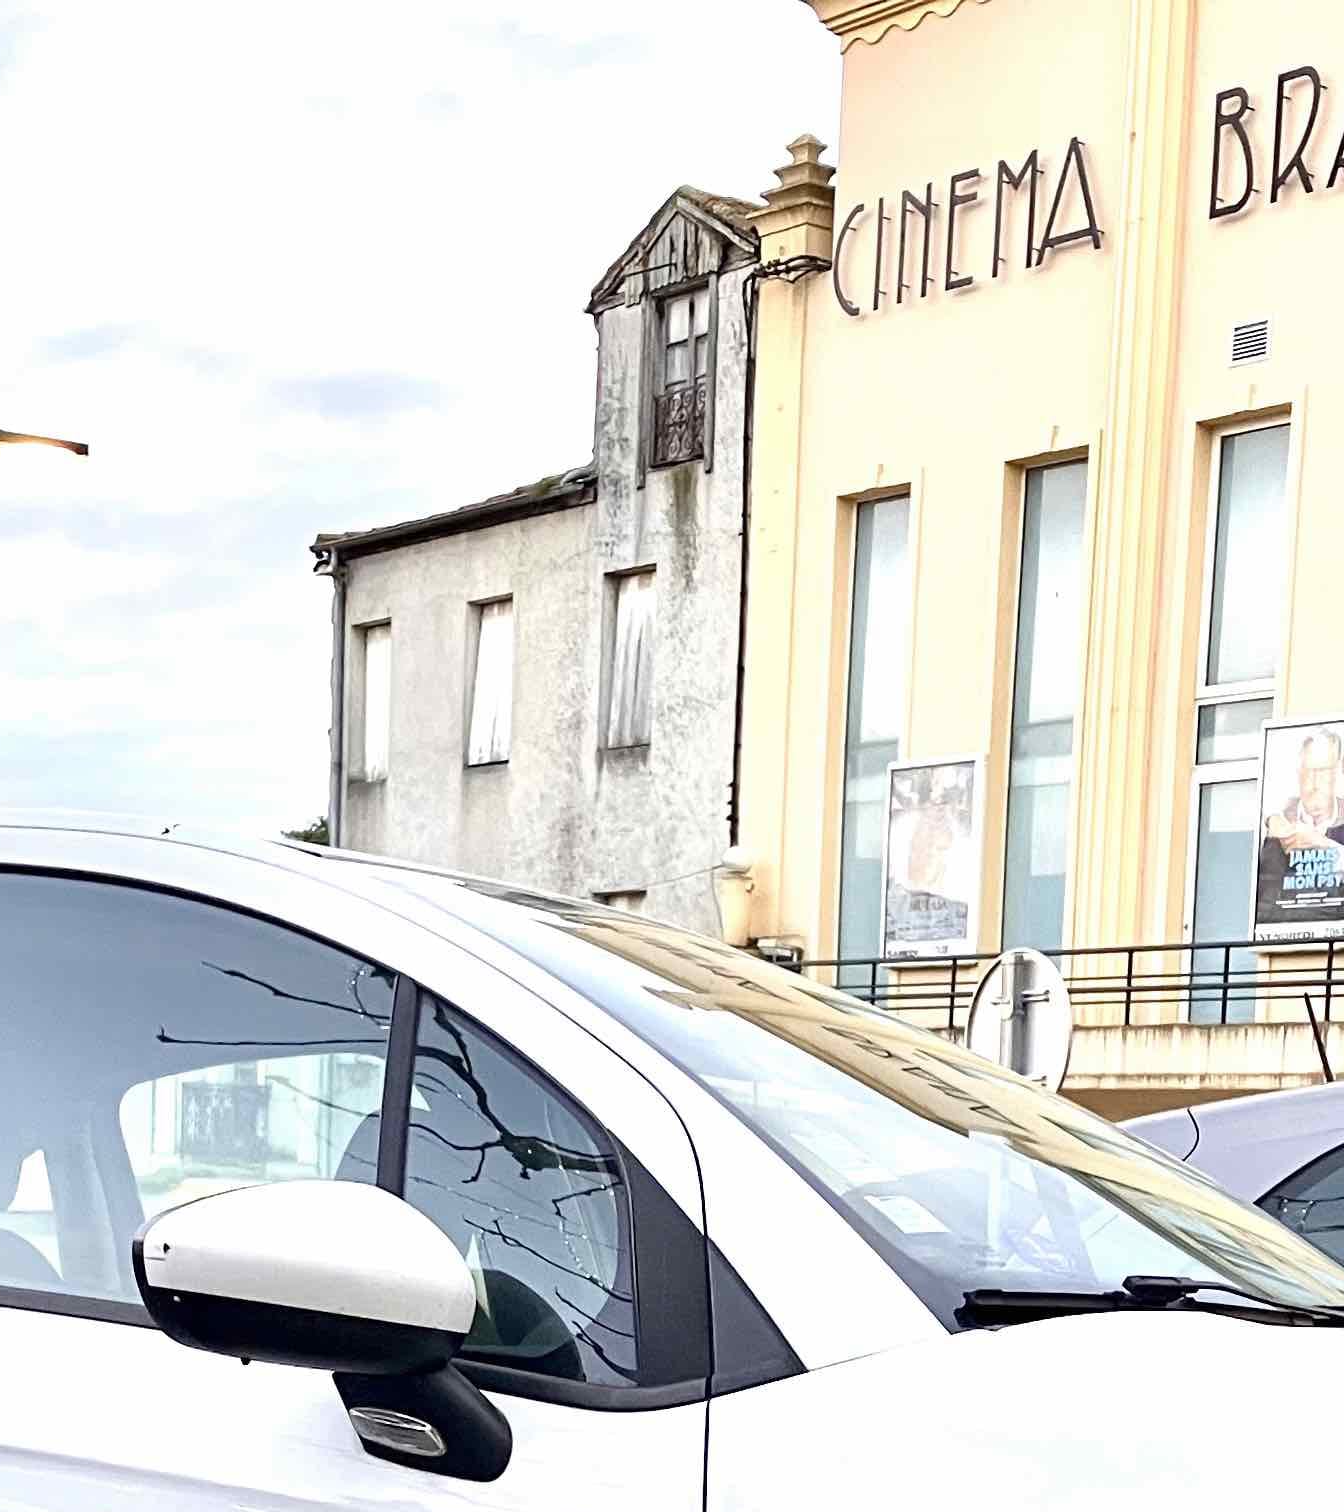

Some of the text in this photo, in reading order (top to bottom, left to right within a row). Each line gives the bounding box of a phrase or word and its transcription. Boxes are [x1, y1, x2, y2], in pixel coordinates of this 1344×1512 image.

[832, 136, 1104, 318] CINEMA
[1283, 873, 1343, 890] MON PSY
